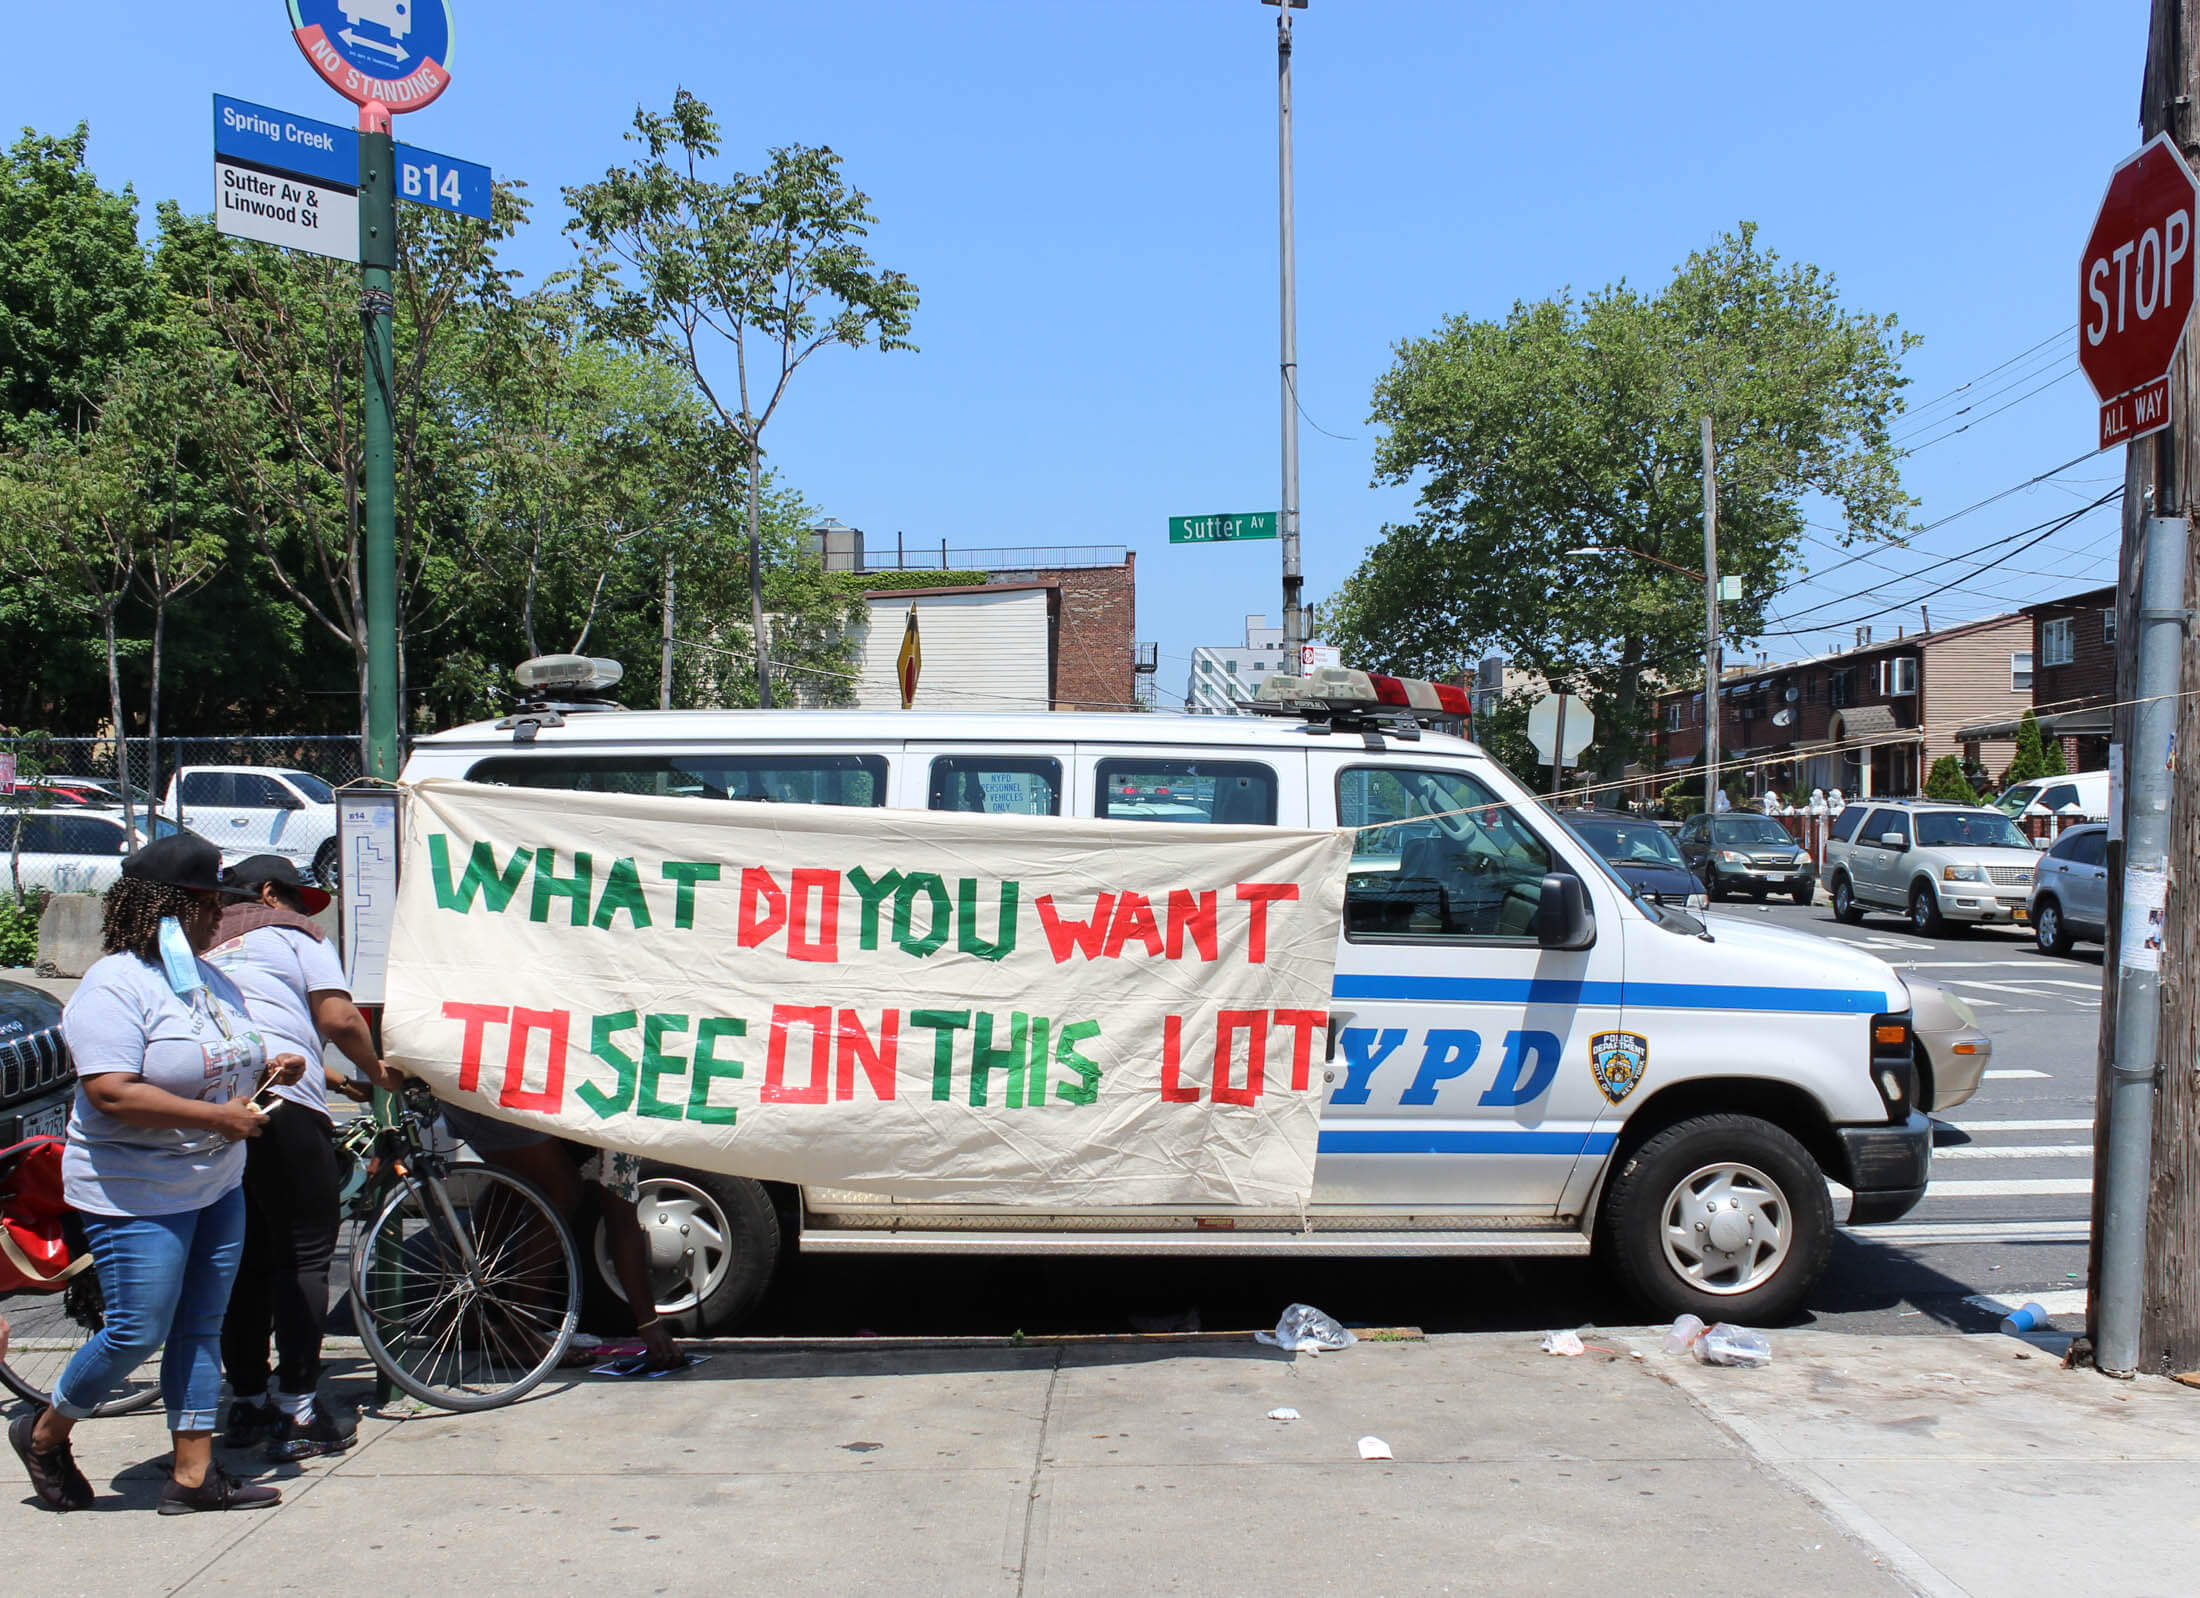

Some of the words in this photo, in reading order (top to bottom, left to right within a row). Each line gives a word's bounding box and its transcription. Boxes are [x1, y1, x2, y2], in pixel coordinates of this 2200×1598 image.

[311, 38, 341, 72] NO
[345, 67, 440, 103] STANDING
[223, 107, 281, 141] Spring
[285, 123, 334, 152] Creek
[224, 169, 276, 197] Sutter
[280, 182, 301, 203] Av
[305, 190, 319, 208] &
[402, 163, 462, 206] B14
[224, 191, 296, 223] Linwood
[301, 210, 319, 228] St
[2087, 208, 2190, 347] STOP
[2103, 404, 2128, 440] ALL
[2135, 387, 2164, 425] WAY
[1183, 517, 1243, 539] Sutter
[1250, 515, 1265, 529] Av
[982, 783, 1022, 793] PERSONNEL
[990, 792, 1024, 802] VEHICLES
[991, 774, 1012, 783] NYPD
[992, 802, 1012, 812] ONLY
[428, 833, 721, 930] WHAT
[737, 865, 841, 963] DO
[847, 865, 1019, 962] YOU
[1035, 882, 1299, 964] WANT
[1592, 1042, 1646, 1056] DEPARTMENT
[1603, 1033, 1635, 1044] POLICE
[443, 1001, 570, 1115] TO
[575, 1010, 747, 1125] SEE
[760, 1004, 899, 1105] ON
[910, 1010, 1103, 1109] THIS
[1161, 1008, 1327, 1108] LOT
[1329, 1027, 1562, 1107] YPD
[1593, 1063, 1604, 1081] CITY
[1601, 1083, 1612, 1097] OF
[1621, 1081, 1635, 1097] NEW
[1634, 1060, 1646, 1079] YORK
